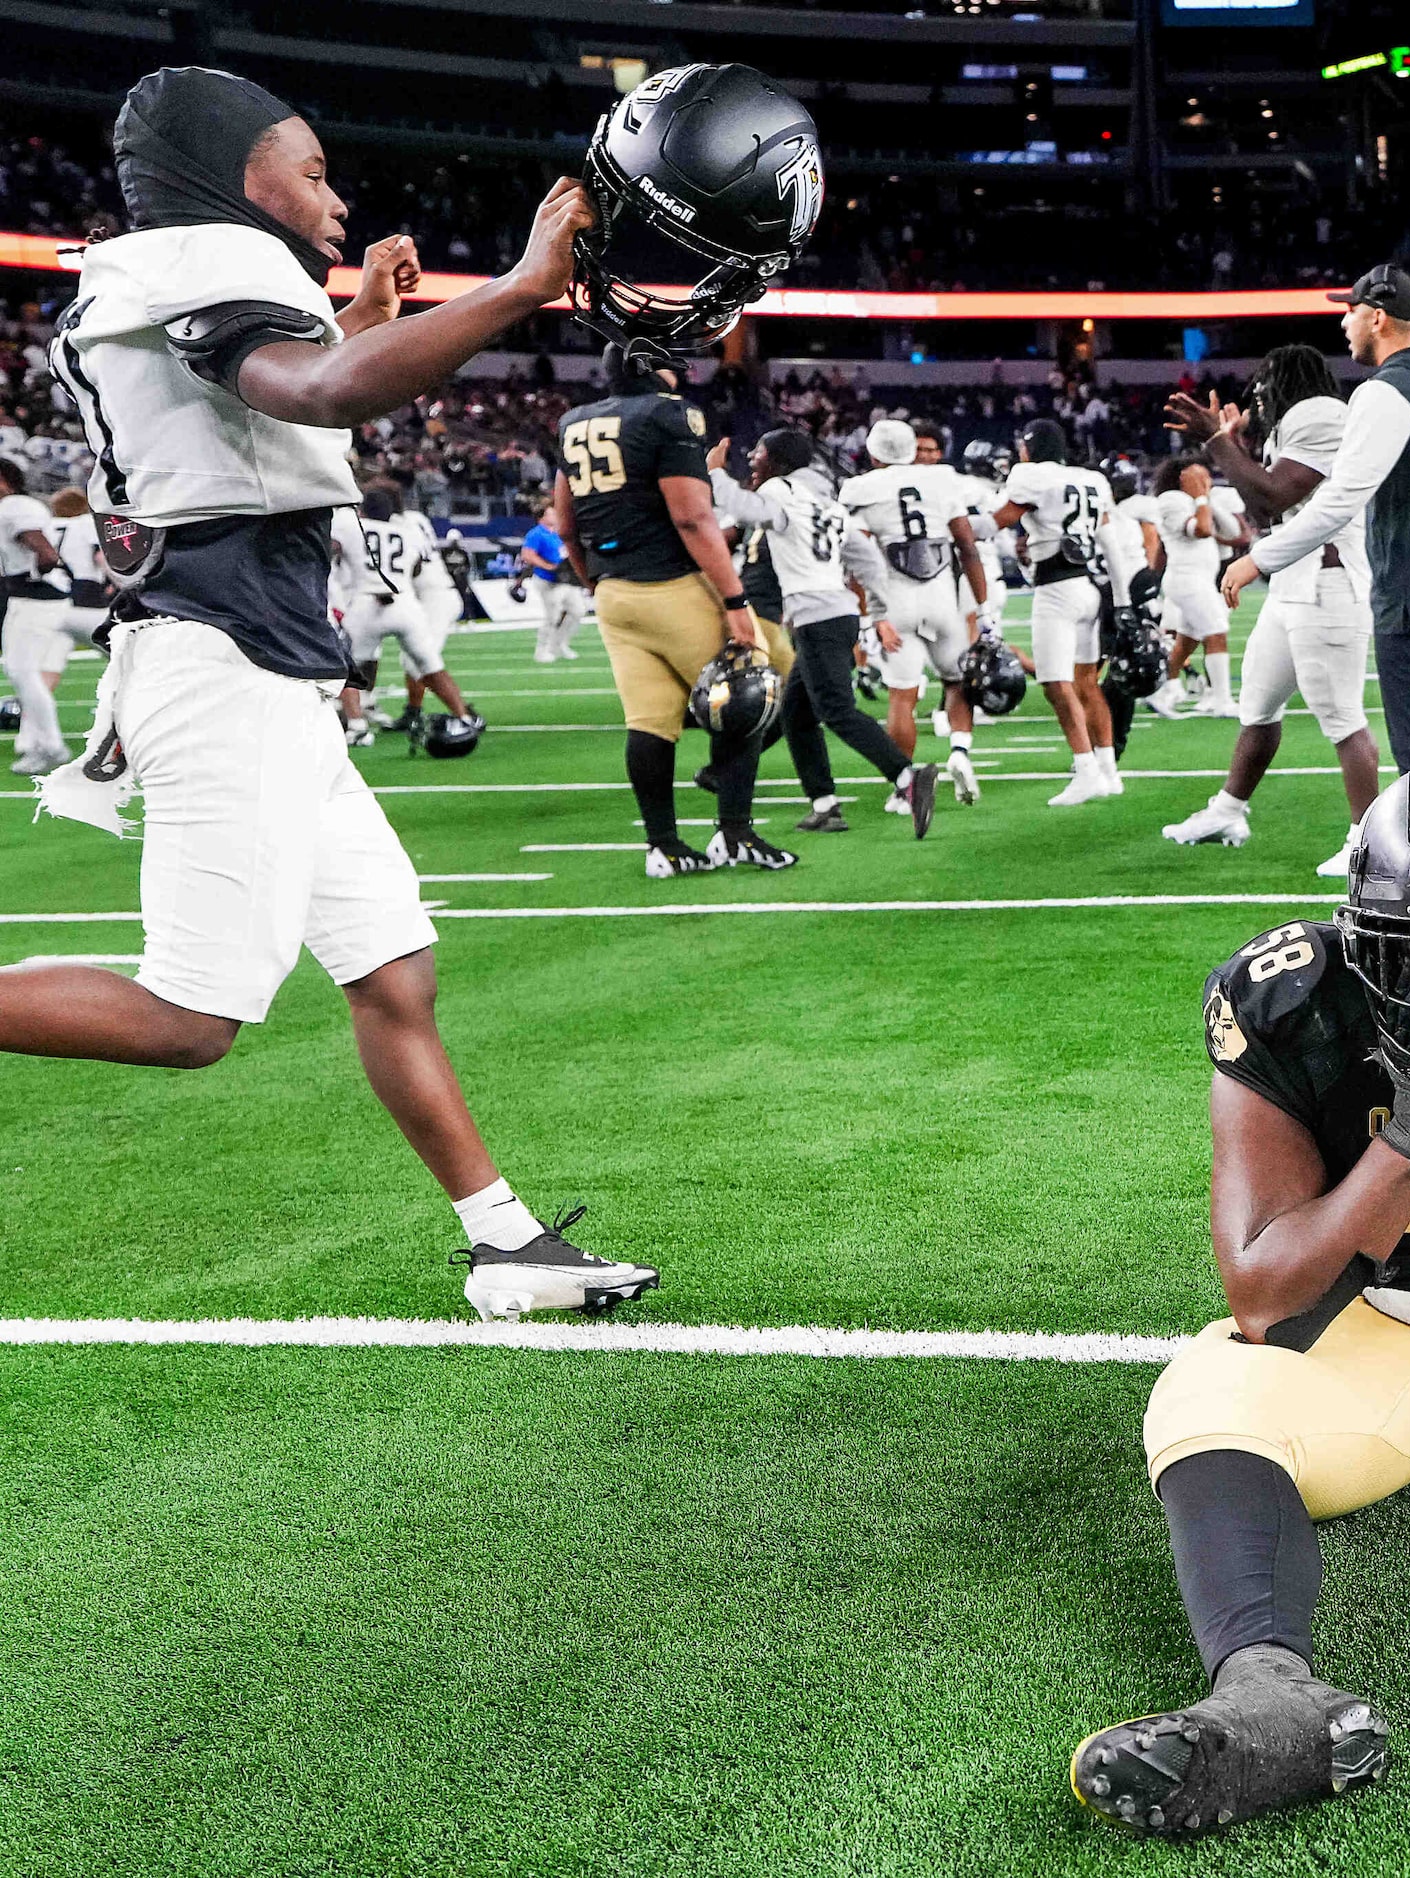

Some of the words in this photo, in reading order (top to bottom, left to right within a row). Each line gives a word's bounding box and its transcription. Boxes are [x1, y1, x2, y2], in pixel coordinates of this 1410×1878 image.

[639, 176, 696, 223] Riddell
[563, 416, 627, 497] 55
[899, 487, 928, 541] 6
[366, 531, 404, 573] 92
[1239, 922, 1315, 983] 58
